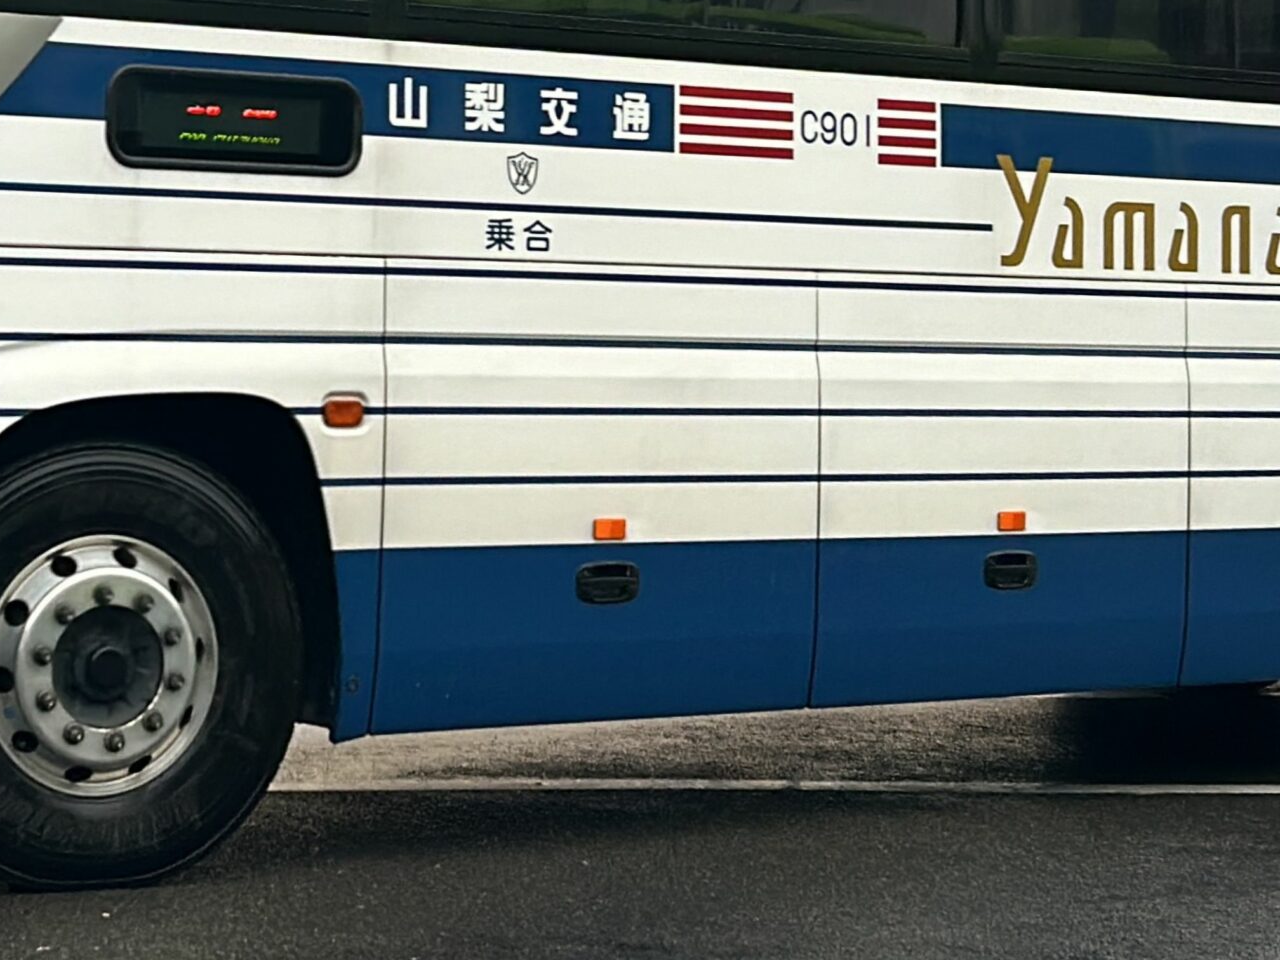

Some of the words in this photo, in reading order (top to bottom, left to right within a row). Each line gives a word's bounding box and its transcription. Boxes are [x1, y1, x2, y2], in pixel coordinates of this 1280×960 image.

[388, 76, 651, 141] 山梨交通
[800, 112, 871, 147] C901
[485, 218, 553, 252] 乗合
